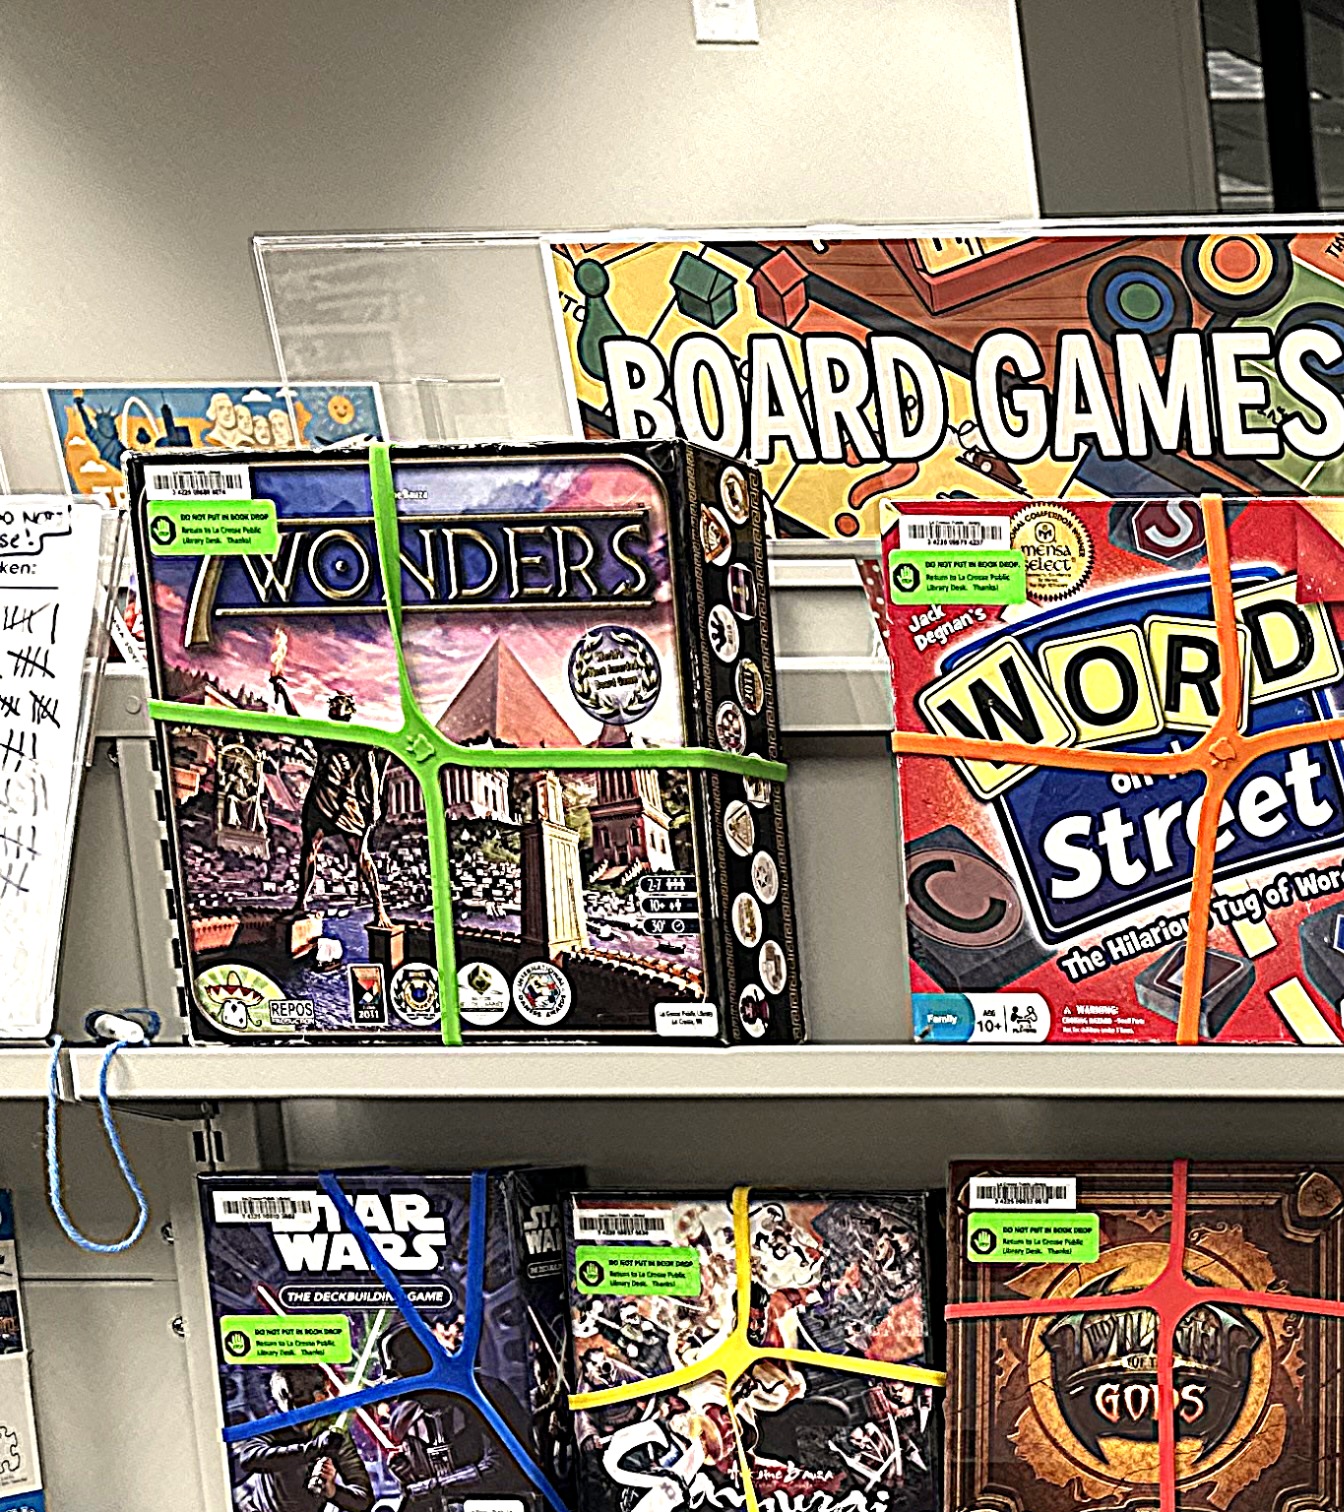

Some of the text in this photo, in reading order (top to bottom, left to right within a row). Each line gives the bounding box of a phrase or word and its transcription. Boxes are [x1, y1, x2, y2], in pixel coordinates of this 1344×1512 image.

[603, 329, 948, 466] BOARD
[242, 524, 650, 603] WONDERS
[908, 605, 946, 633] Jack
[914, 608, 987, 649] Degnan's
[933, 599, 1318, 747] WORD
[1043, 749, 1337, 901] Street
[1061, 945, 1106, 981] The
[1216, 891, 1263, 928] Tug
[1264, 879, 1293, 907] of
[274, 1234, 447, 1271] WARS
